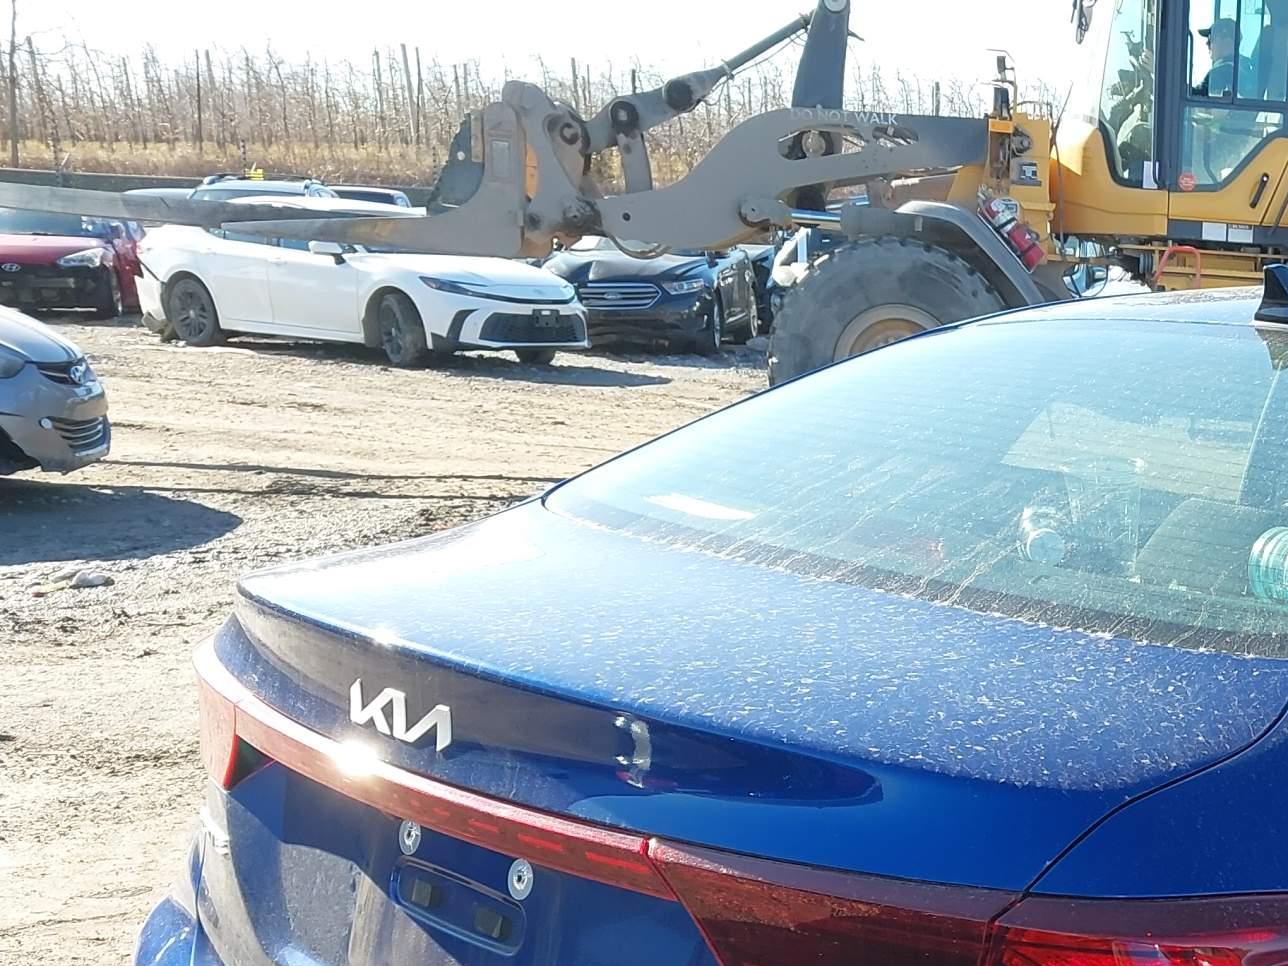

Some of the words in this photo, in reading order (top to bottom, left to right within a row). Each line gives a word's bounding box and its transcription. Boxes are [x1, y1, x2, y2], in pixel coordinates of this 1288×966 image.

[817, 110, 849, 122] NOT
[855, 112, 898, 125] WALK
[350, 678, 452, 752] KIA
